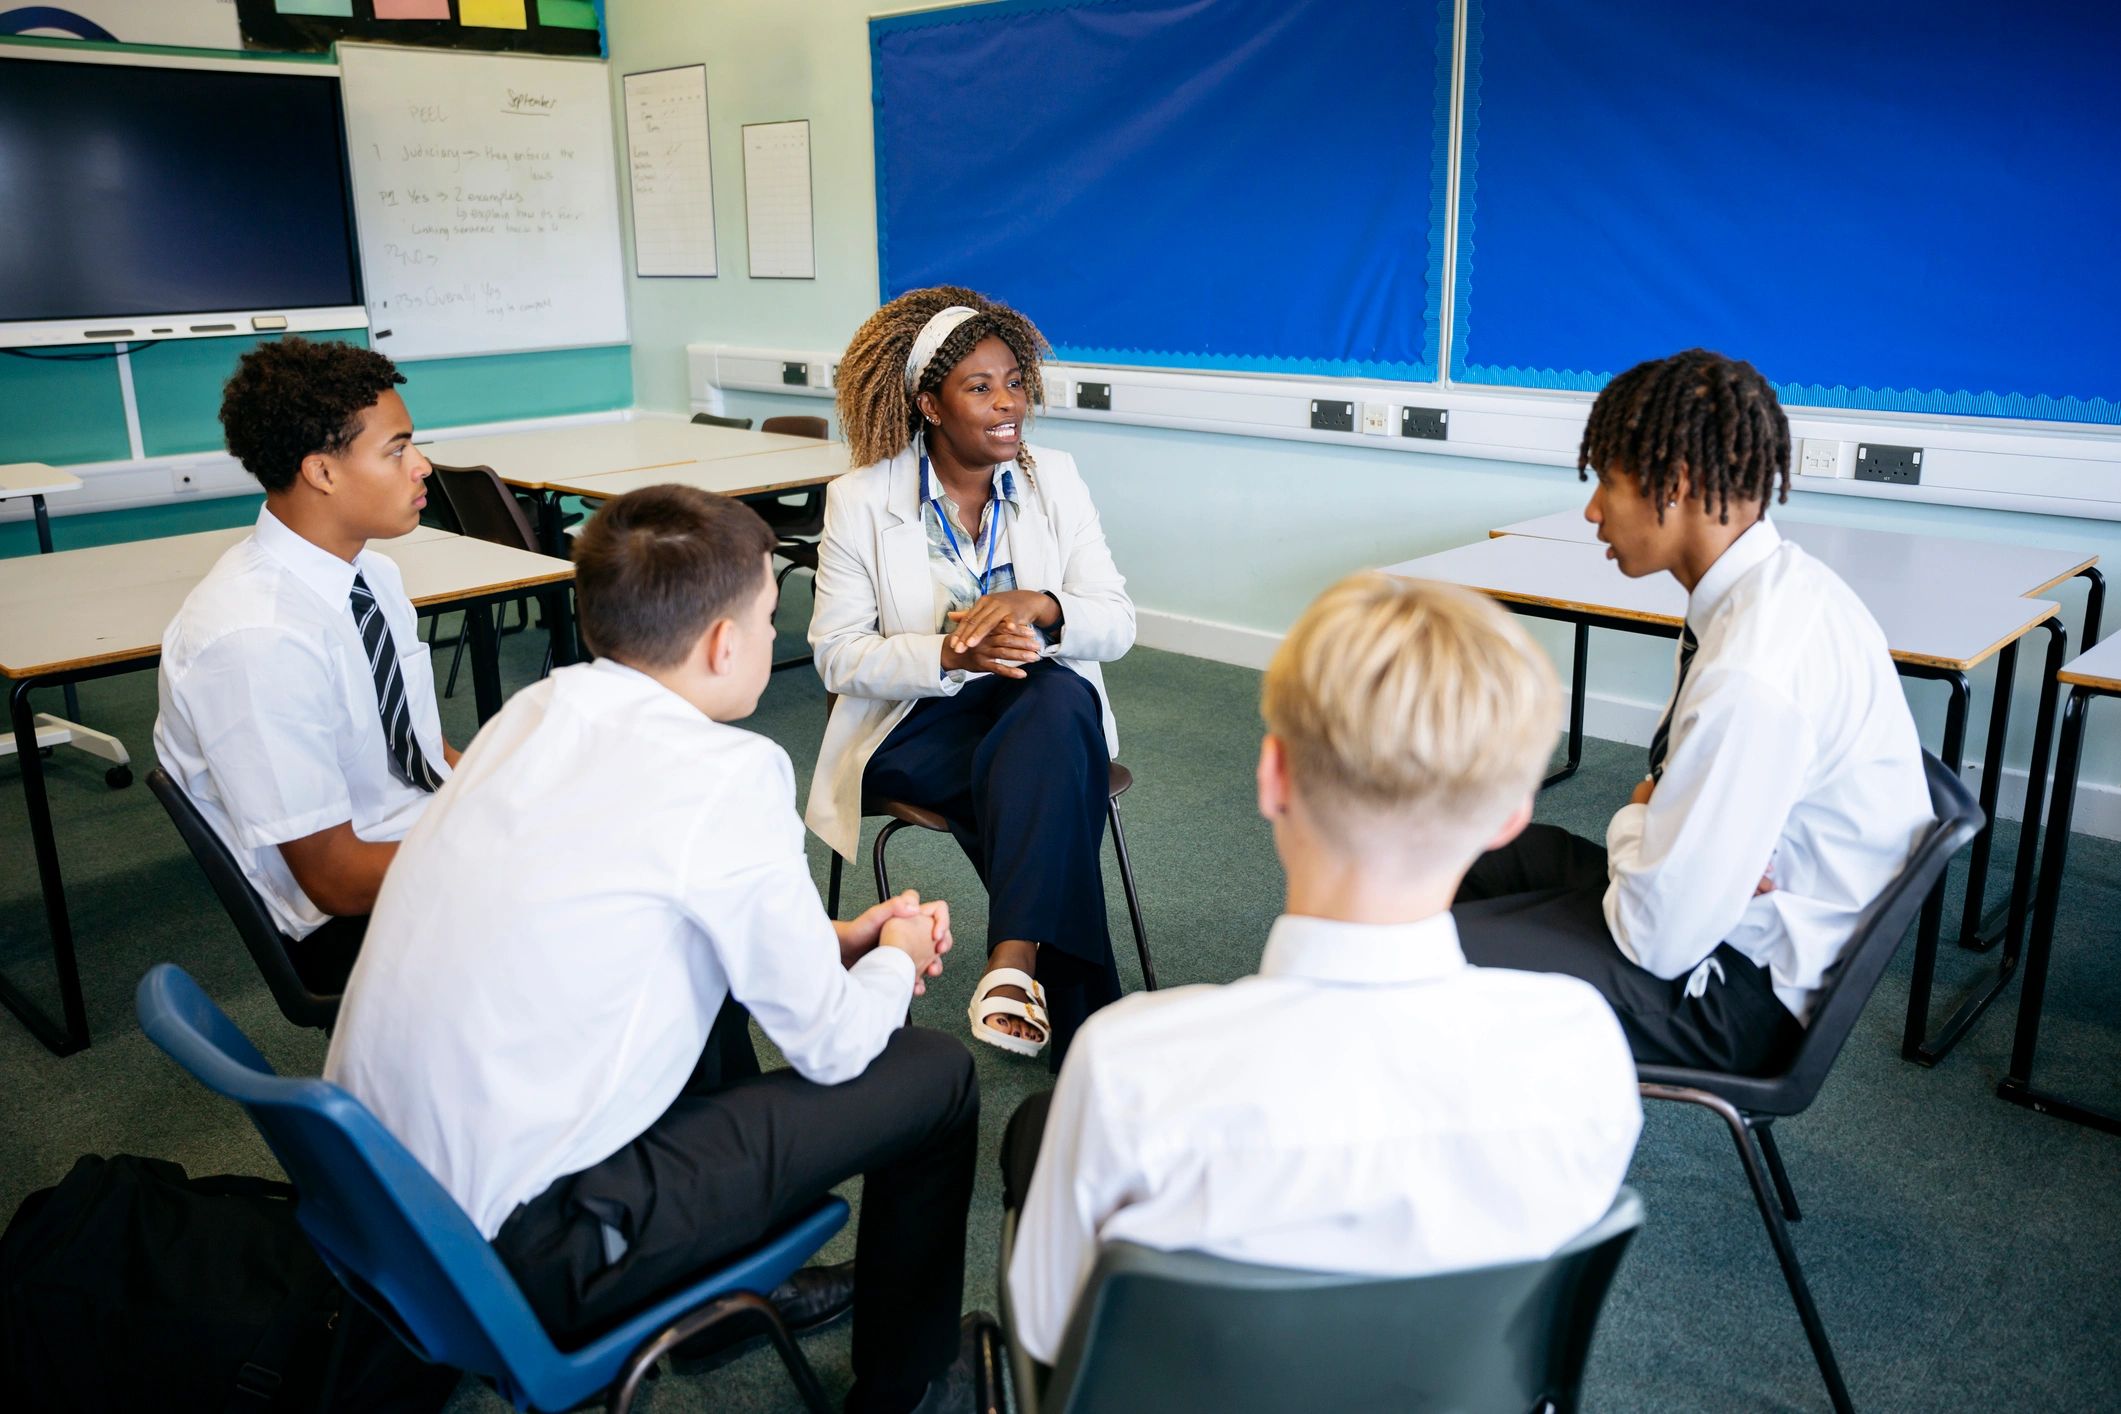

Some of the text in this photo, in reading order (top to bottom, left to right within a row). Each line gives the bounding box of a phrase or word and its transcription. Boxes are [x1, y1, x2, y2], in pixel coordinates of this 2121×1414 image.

[507, 88, 557, 109] September
[408, 105, 449, 123] PEEL
[401, 144, 460, 173] Judiciary
[407, 188, 430, 204] Yes
[454, 186, 463, 202] 2
[467, 188, 524, 206] examples
